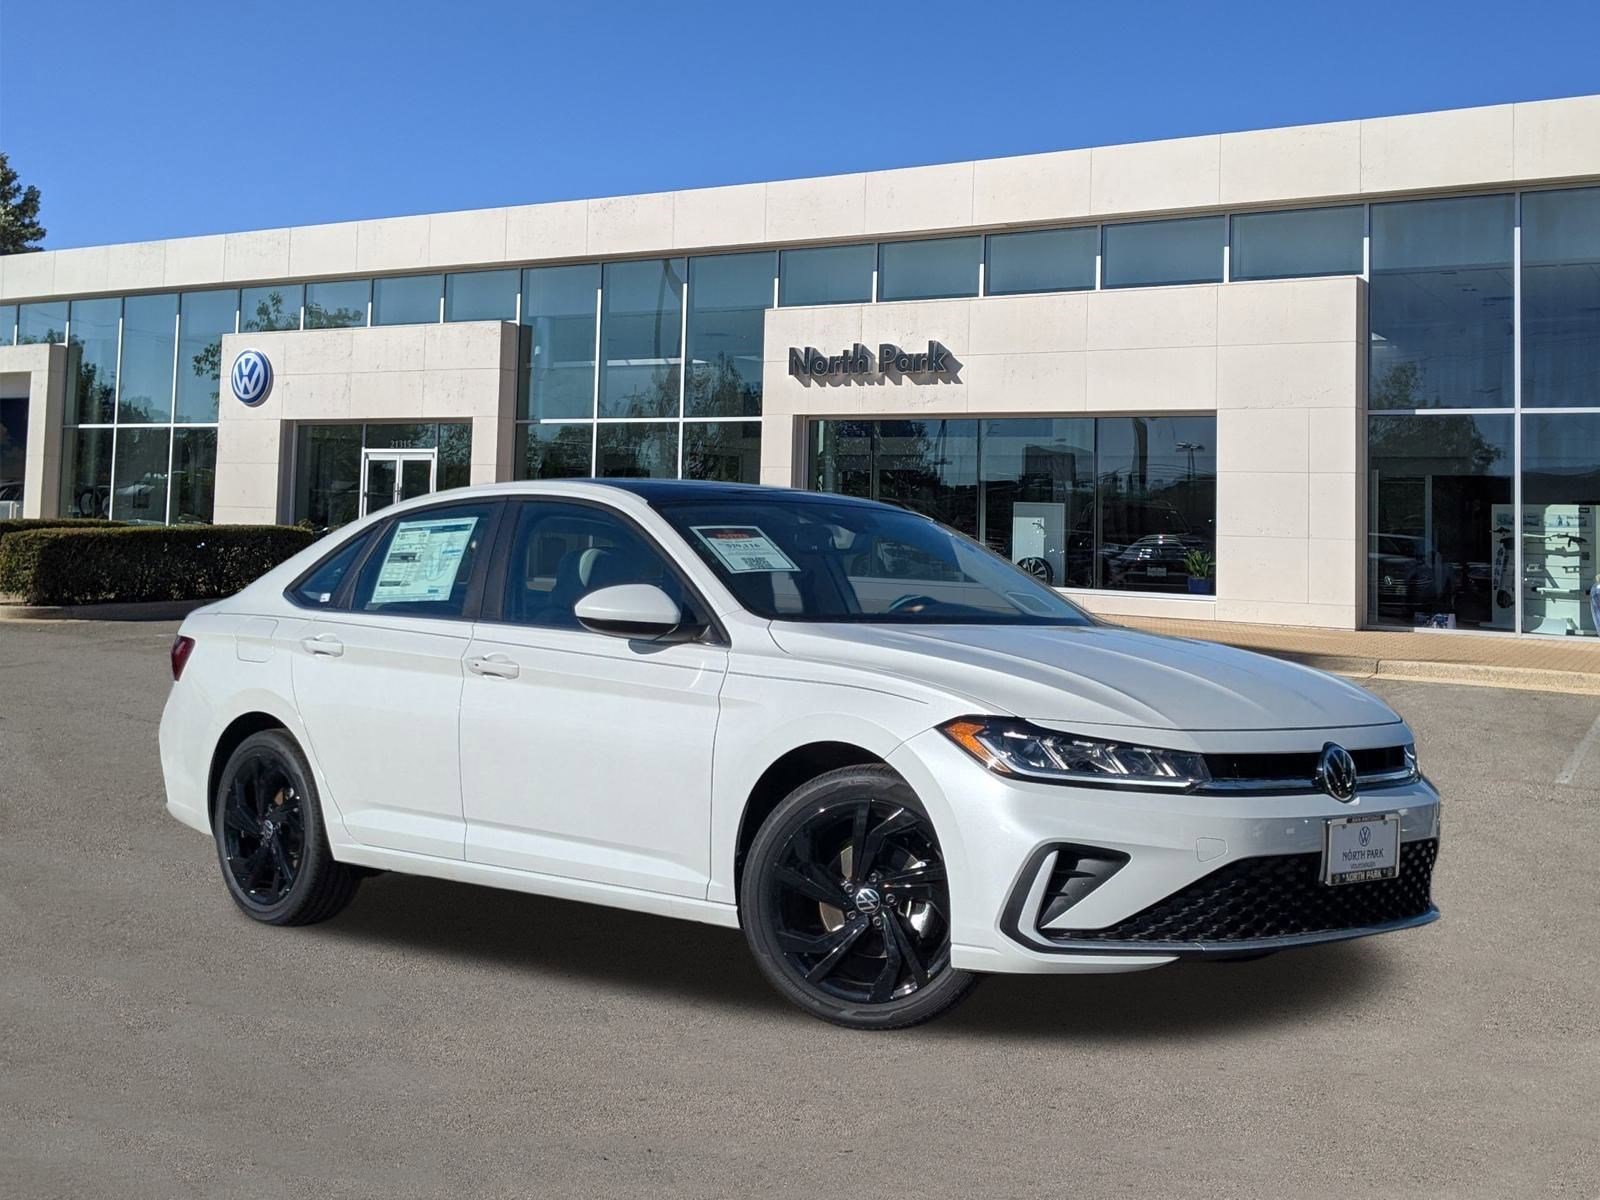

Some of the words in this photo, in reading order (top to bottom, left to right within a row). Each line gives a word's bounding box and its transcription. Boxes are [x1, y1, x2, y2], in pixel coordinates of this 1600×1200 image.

[788, 342, 873, 376] North
[878, 340, 951, 373] Park
[1342, 849, 1366, 861] NORTH
[1366, 848, 1384, 859] PARK
[1346, 870, 1365, 881] NORTH
[1366, 869, 1382, 880] PARK
